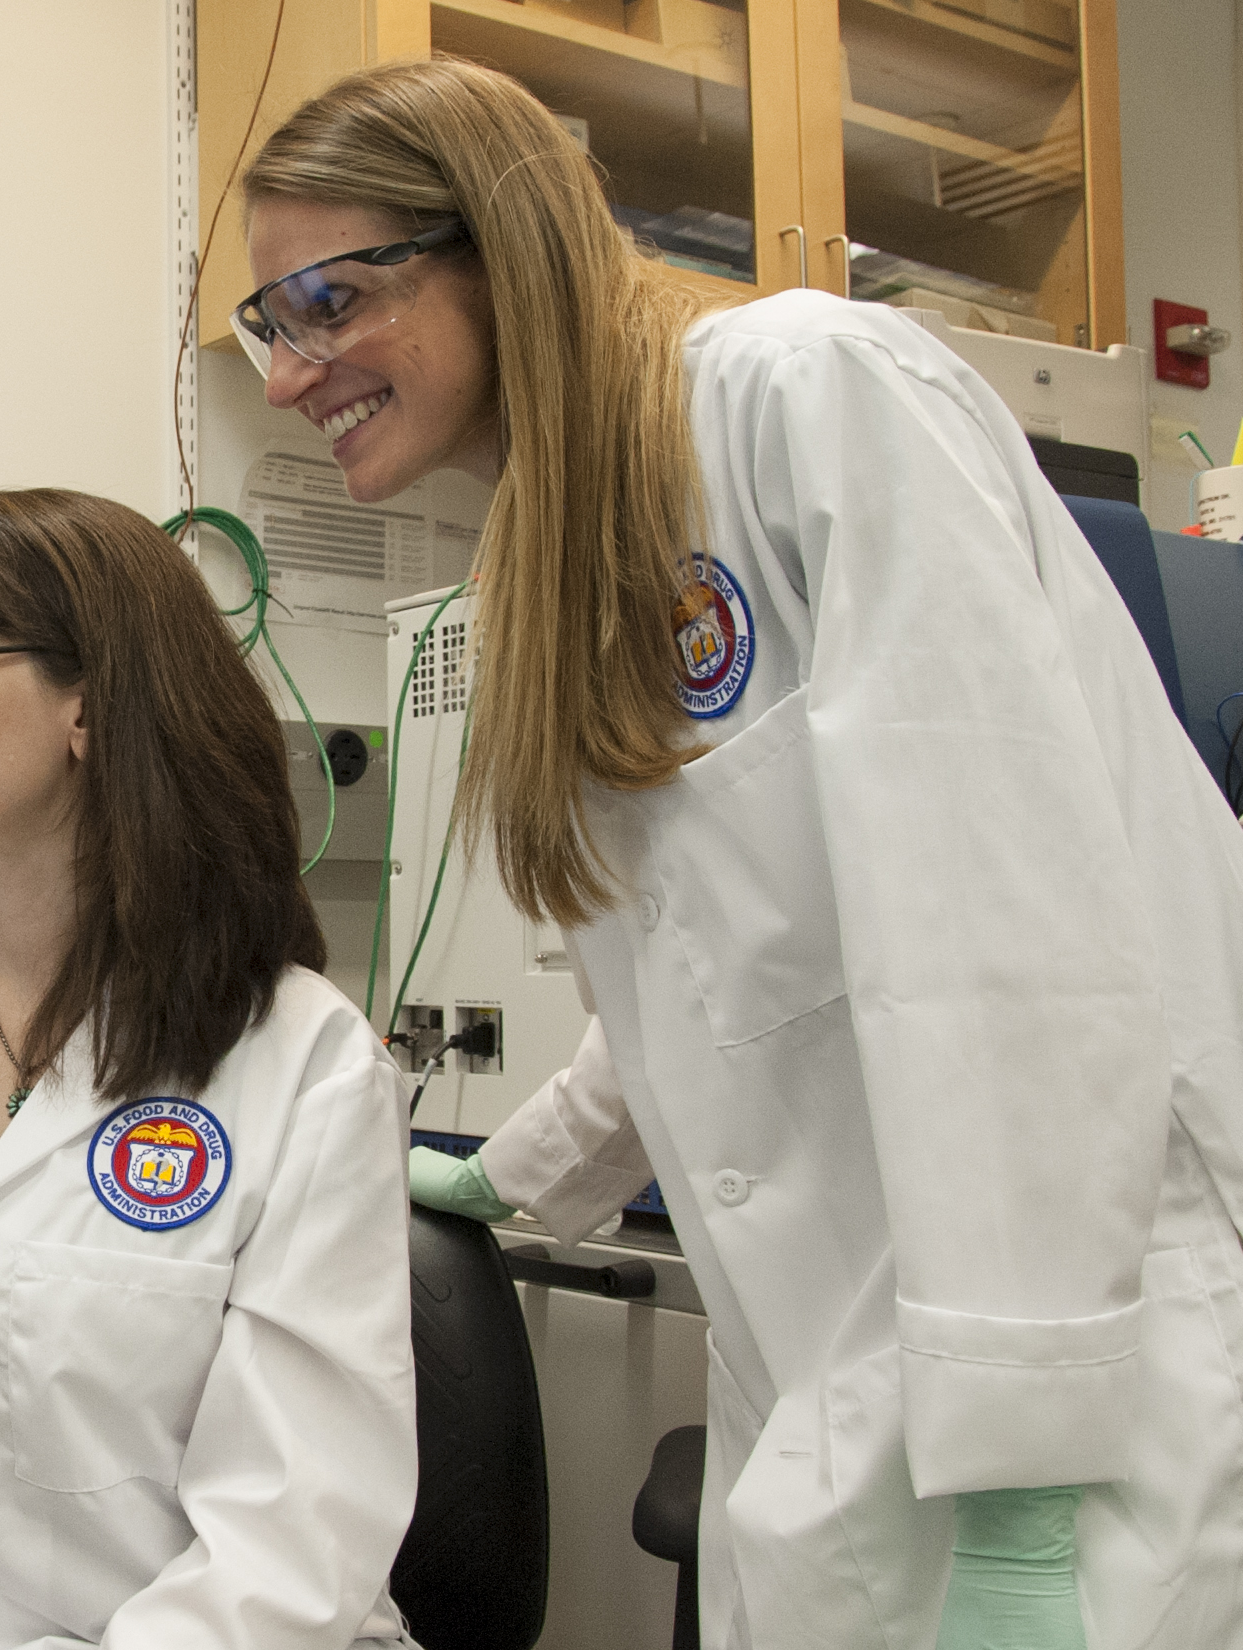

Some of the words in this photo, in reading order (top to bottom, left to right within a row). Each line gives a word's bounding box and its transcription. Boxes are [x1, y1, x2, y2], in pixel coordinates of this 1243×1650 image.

[711, 570, 734, 602] RUG
[123, 1104, 164, 1126] FOOD
[168, 1105, 200, 1123] AND
[198, 1120, 223, 1161] DRUG
[98, 1172, 212, 1221] ADMINISTRATION
